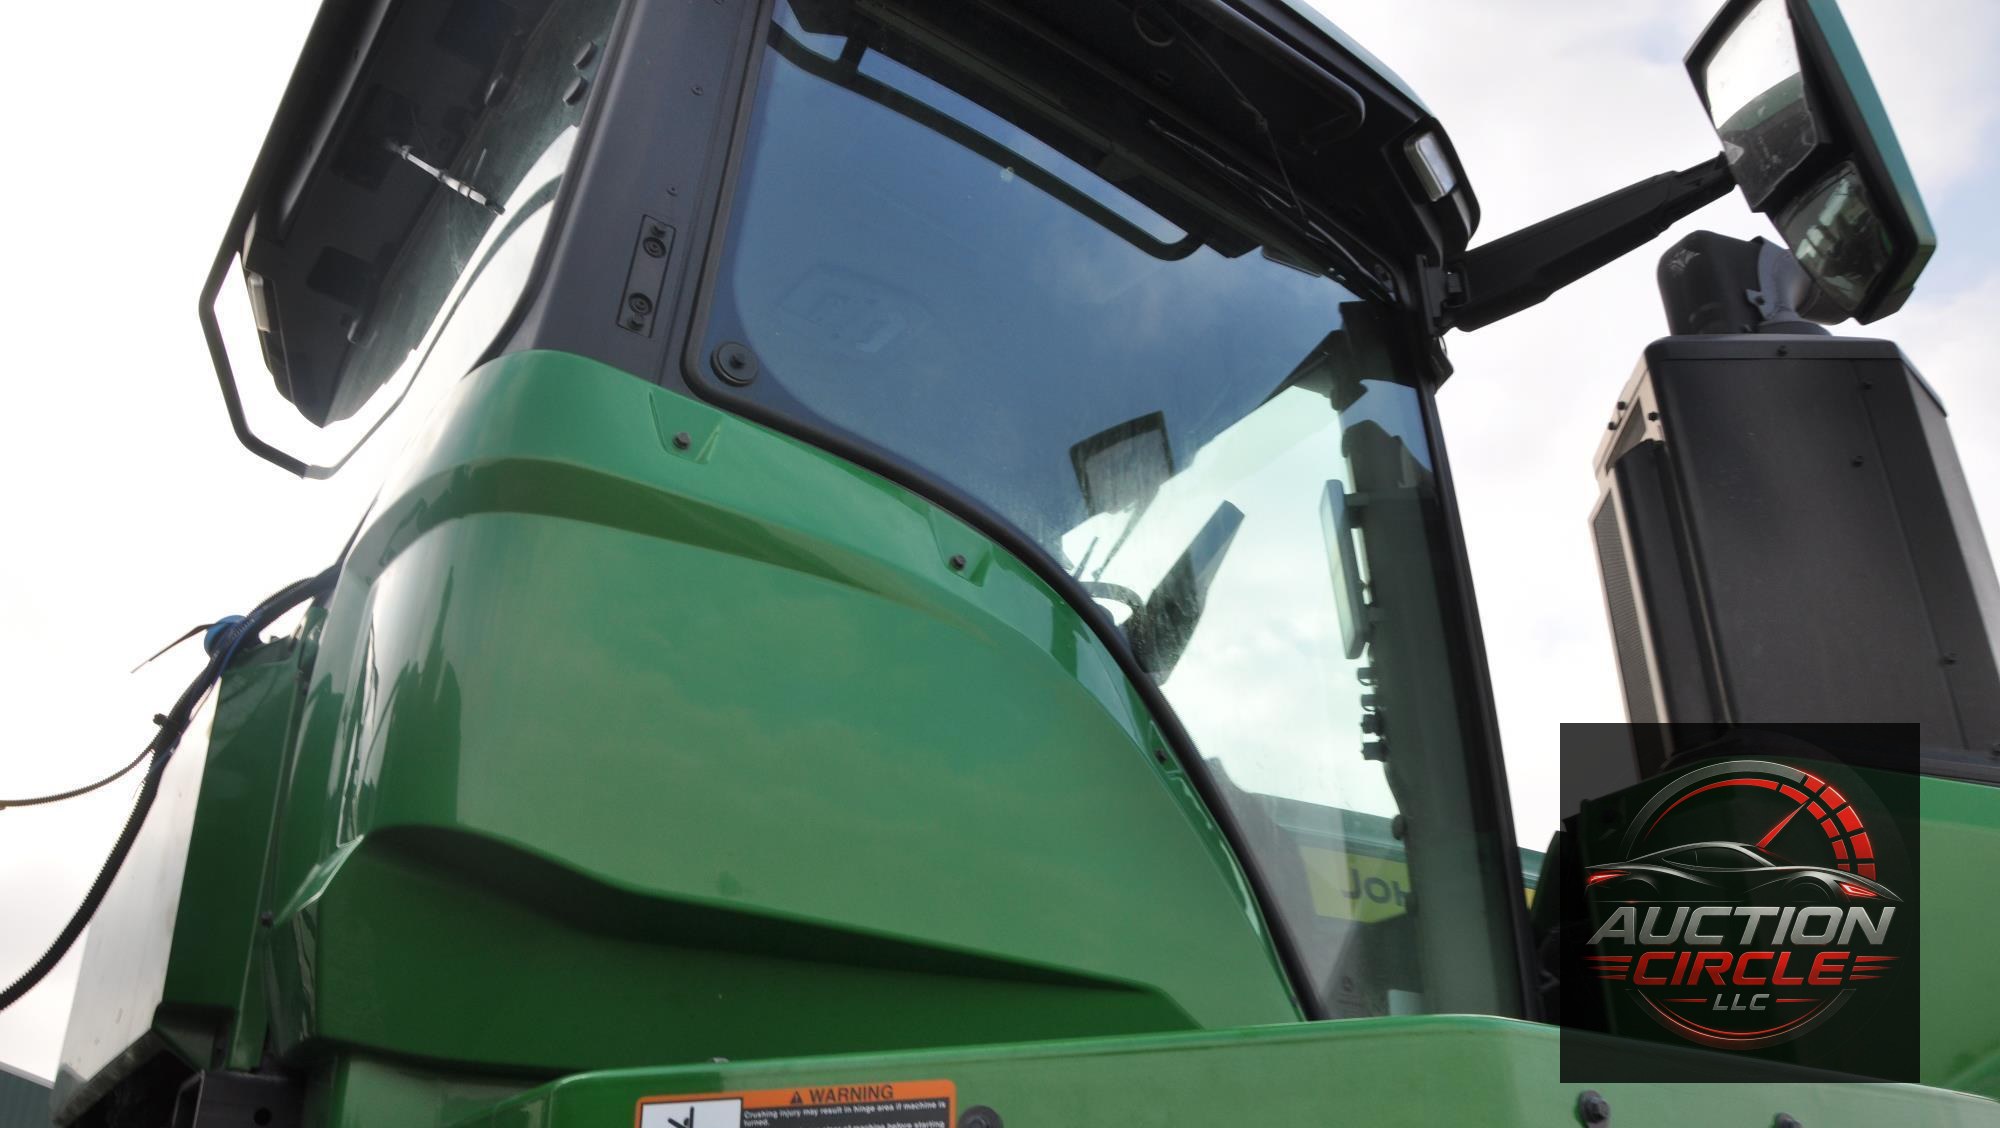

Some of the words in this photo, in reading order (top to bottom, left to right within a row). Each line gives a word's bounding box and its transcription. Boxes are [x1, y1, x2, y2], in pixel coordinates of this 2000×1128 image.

[809, 1084, 894, 1102] WARNING
[743, 1110, 778, 1119] Crushing
[779, 1109, 801, 1118] injury
[803, 1108, 818, 1117] may
[820, 1106, 842, 1114] result
[844, 1105, 852, 1113] in
[853, 1104, 875, 1114] hinge
[877, 1103, 895, 1112] area
[903, 1101, 937, 1111] machine
[938, 1100, 946, 1109] is
